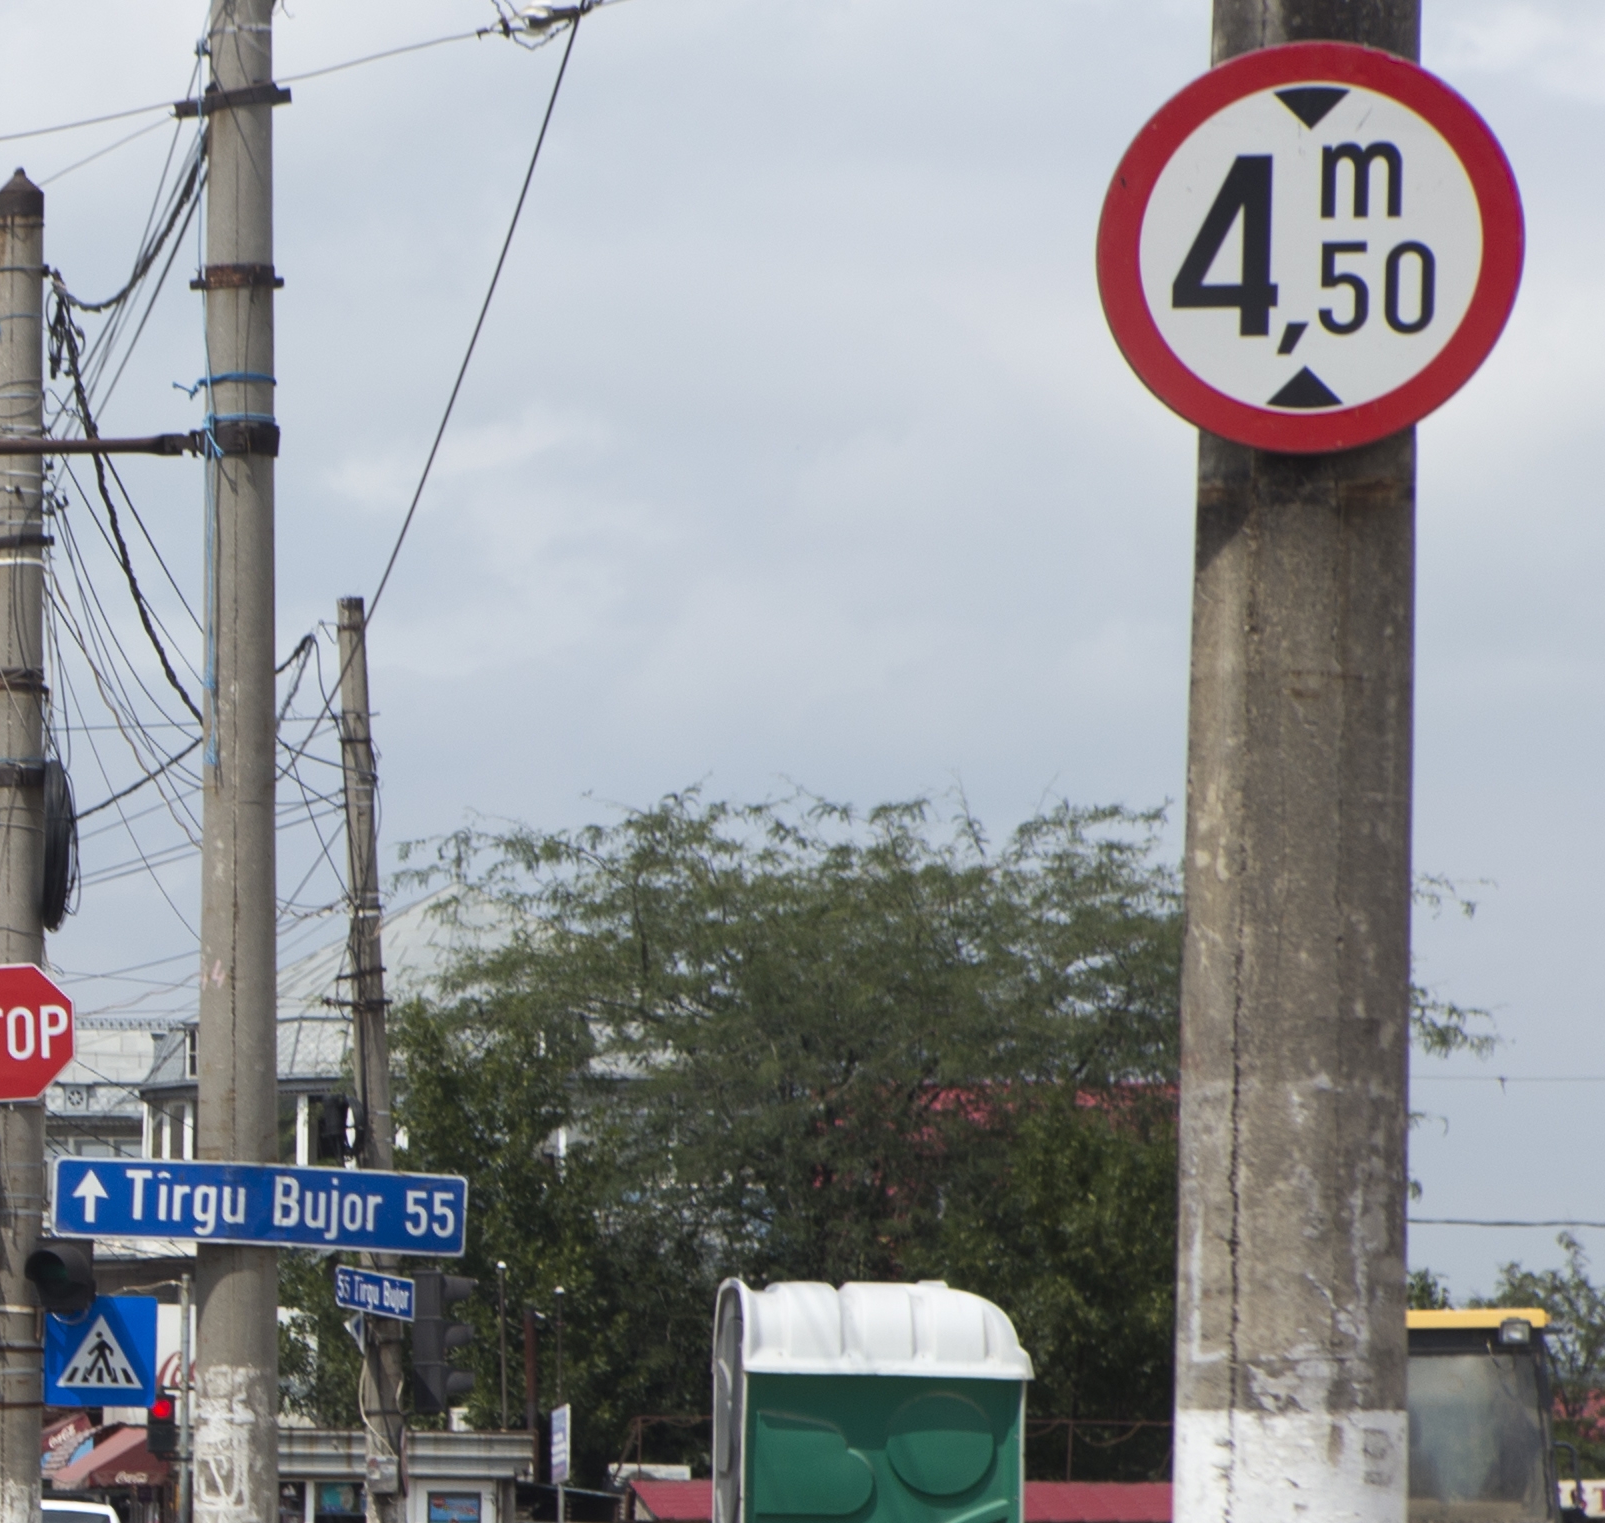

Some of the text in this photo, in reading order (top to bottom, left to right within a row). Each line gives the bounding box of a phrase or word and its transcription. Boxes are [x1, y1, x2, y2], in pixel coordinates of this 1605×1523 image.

[1320, 141, 1403, 219] m
[125, 1169, 456, 1240] Tîrgu Bujor 55
[337, 1274, 350, 1299] 55
[383, 1280, 409, 1314] Bujor
